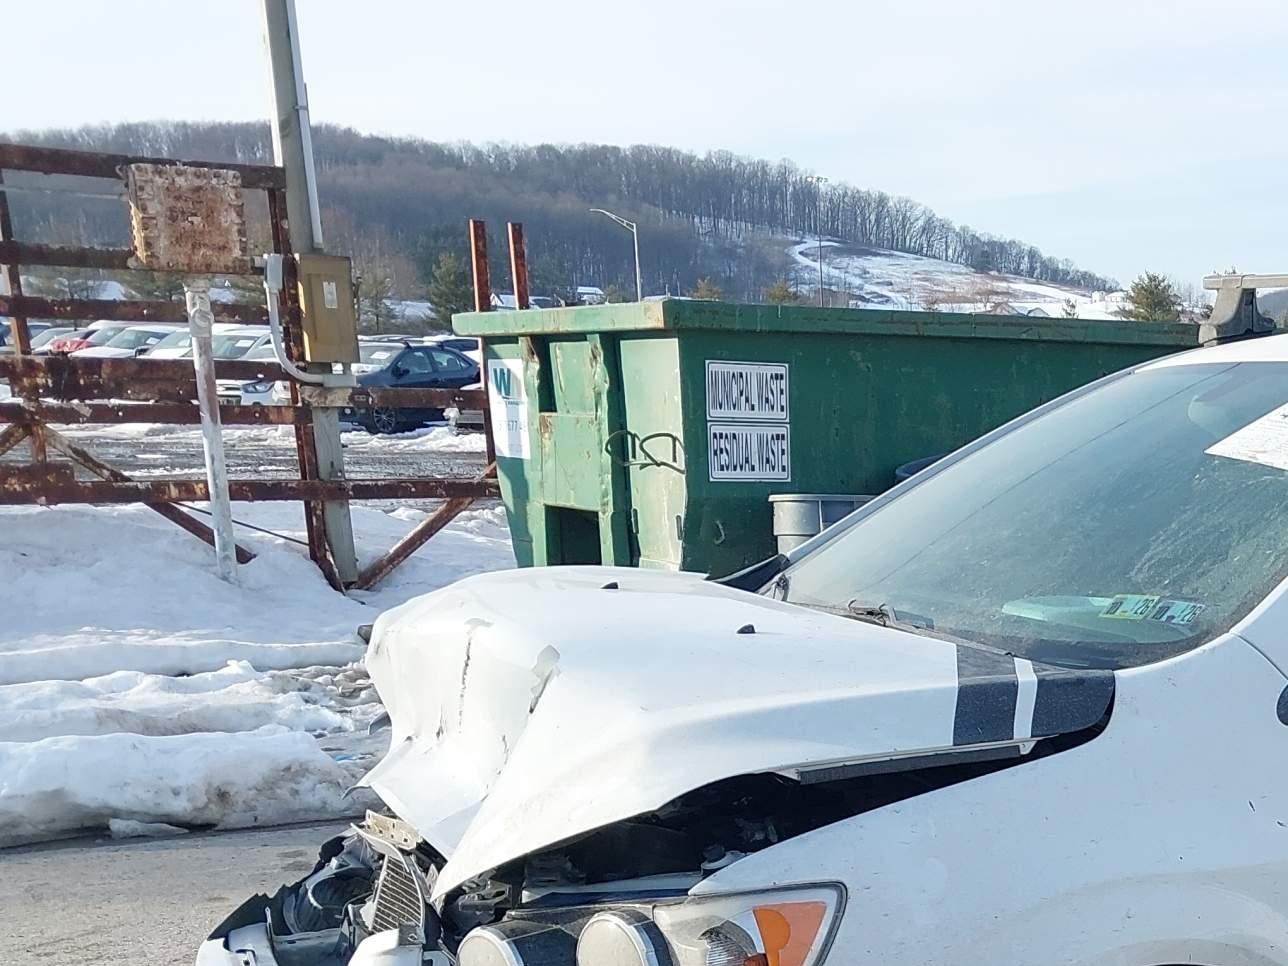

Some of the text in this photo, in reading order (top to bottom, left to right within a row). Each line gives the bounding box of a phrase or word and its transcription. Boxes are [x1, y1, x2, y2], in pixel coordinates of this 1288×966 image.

[710, 370, 785, 413] MUNICIPAL WASTE
[712, 431, 755, 472] RESIDUAL
[756, 432, 786, 473] WASTE
